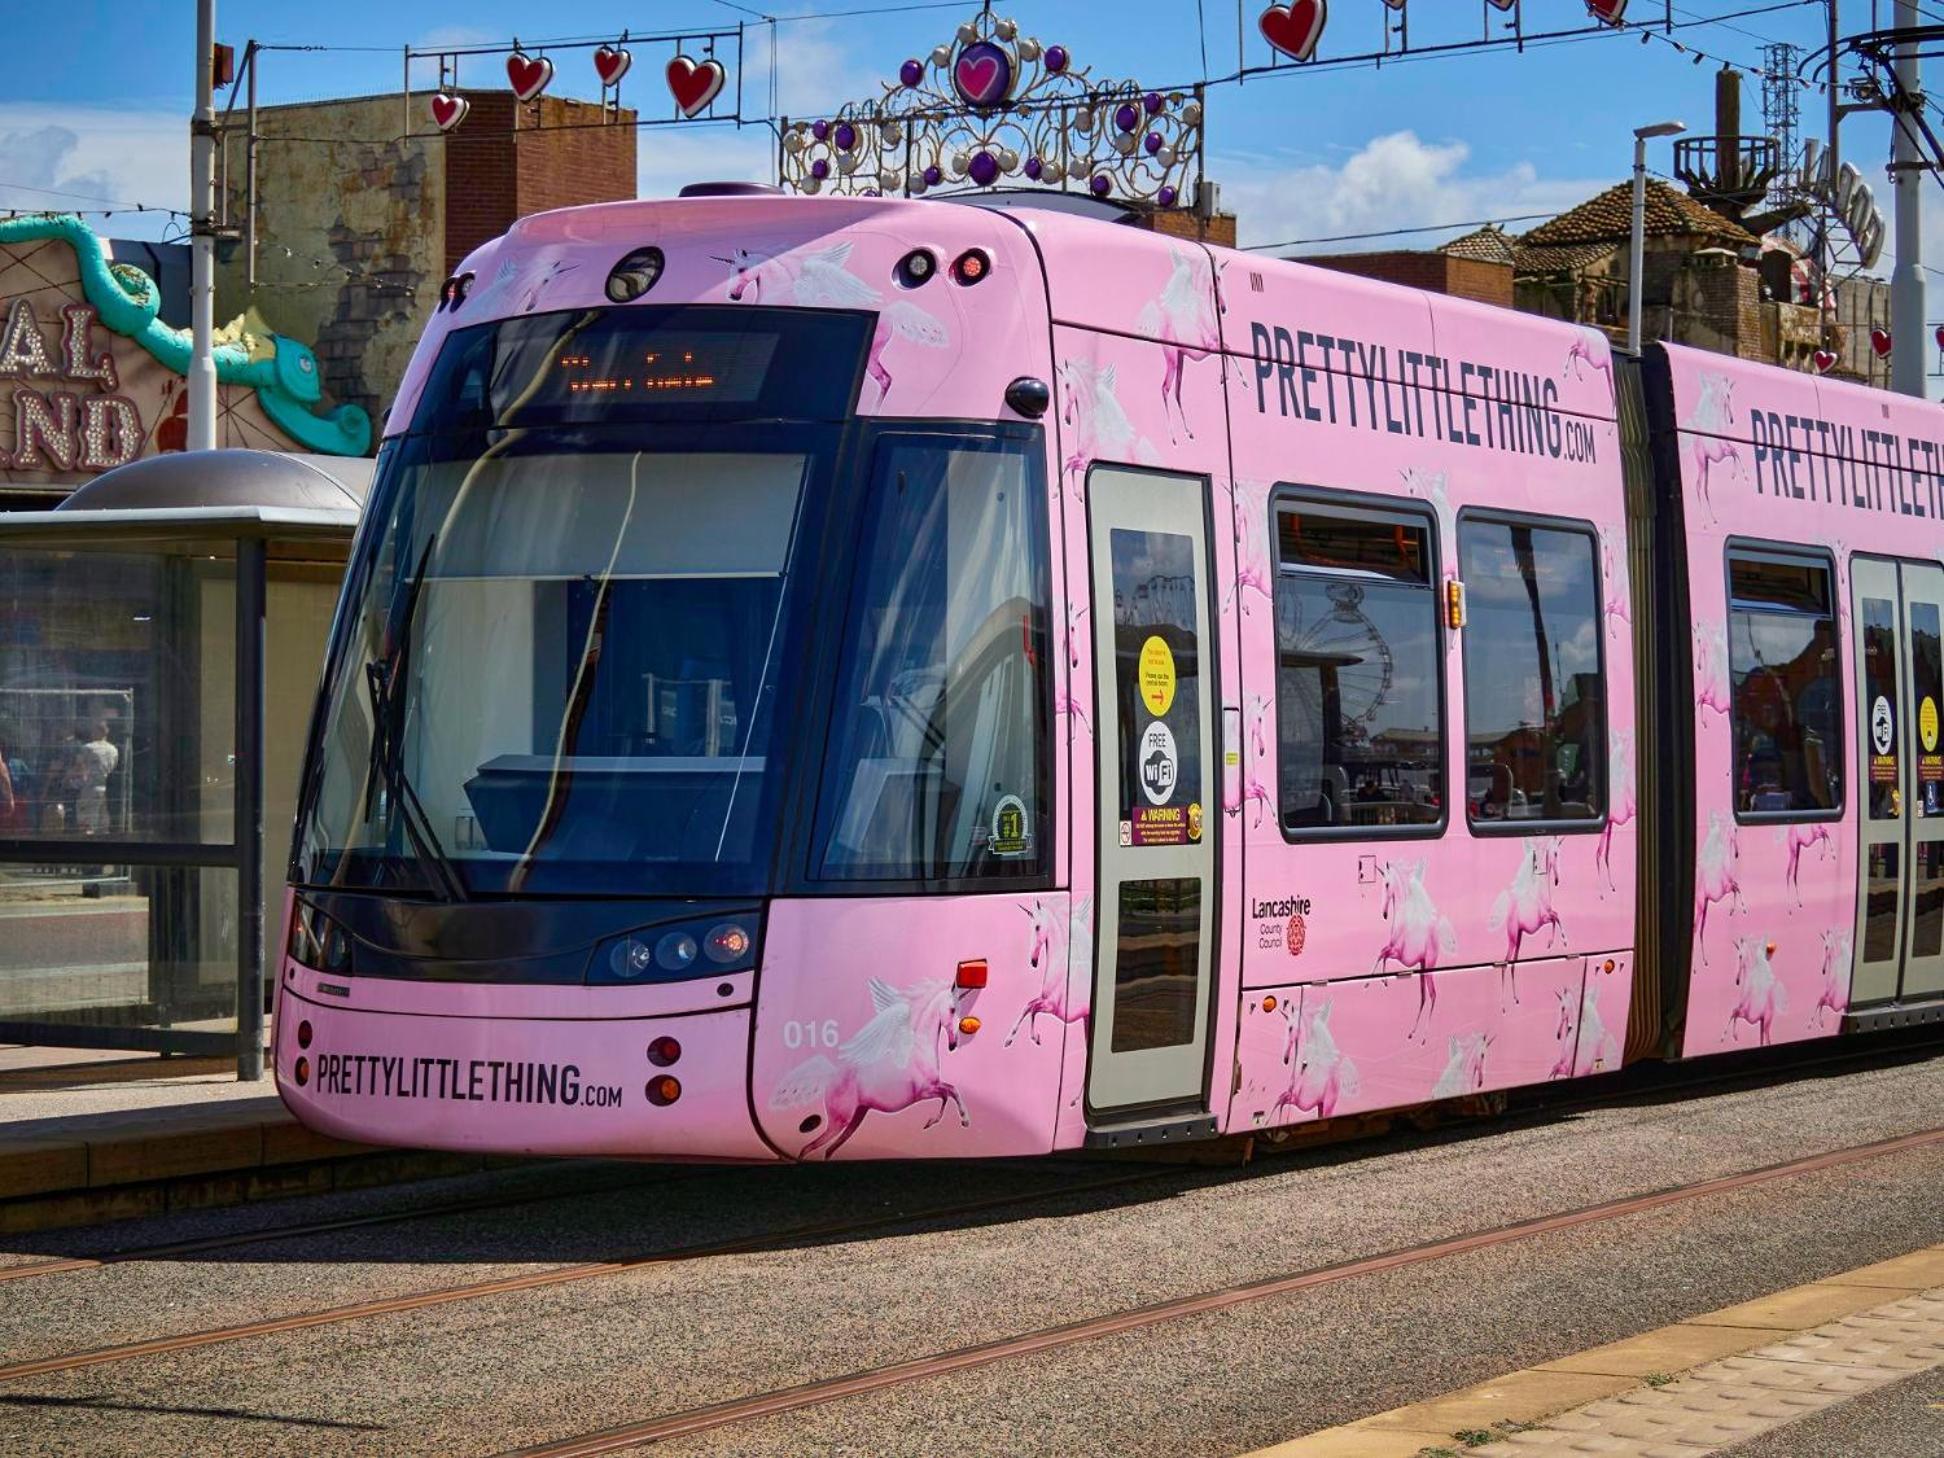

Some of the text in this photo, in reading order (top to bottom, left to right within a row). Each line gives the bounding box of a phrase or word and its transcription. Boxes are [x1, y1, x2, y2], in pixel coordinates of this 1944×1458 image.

[1251, 321, 1597, 465] PRETTYLITTLETHING.COM
[0, 389, 146, 472] ND
[1148, 733, 1166, 748] FREE
[1252, 894, 1311, 919] Lancashire
[1259, 937, 1282, 949] Council
[1260, 923, 1282, 936] County
[783, 1019, 839, 1049] 016
[316, 1054, 623, 1108] PRETTYLITTLETHING.COM
